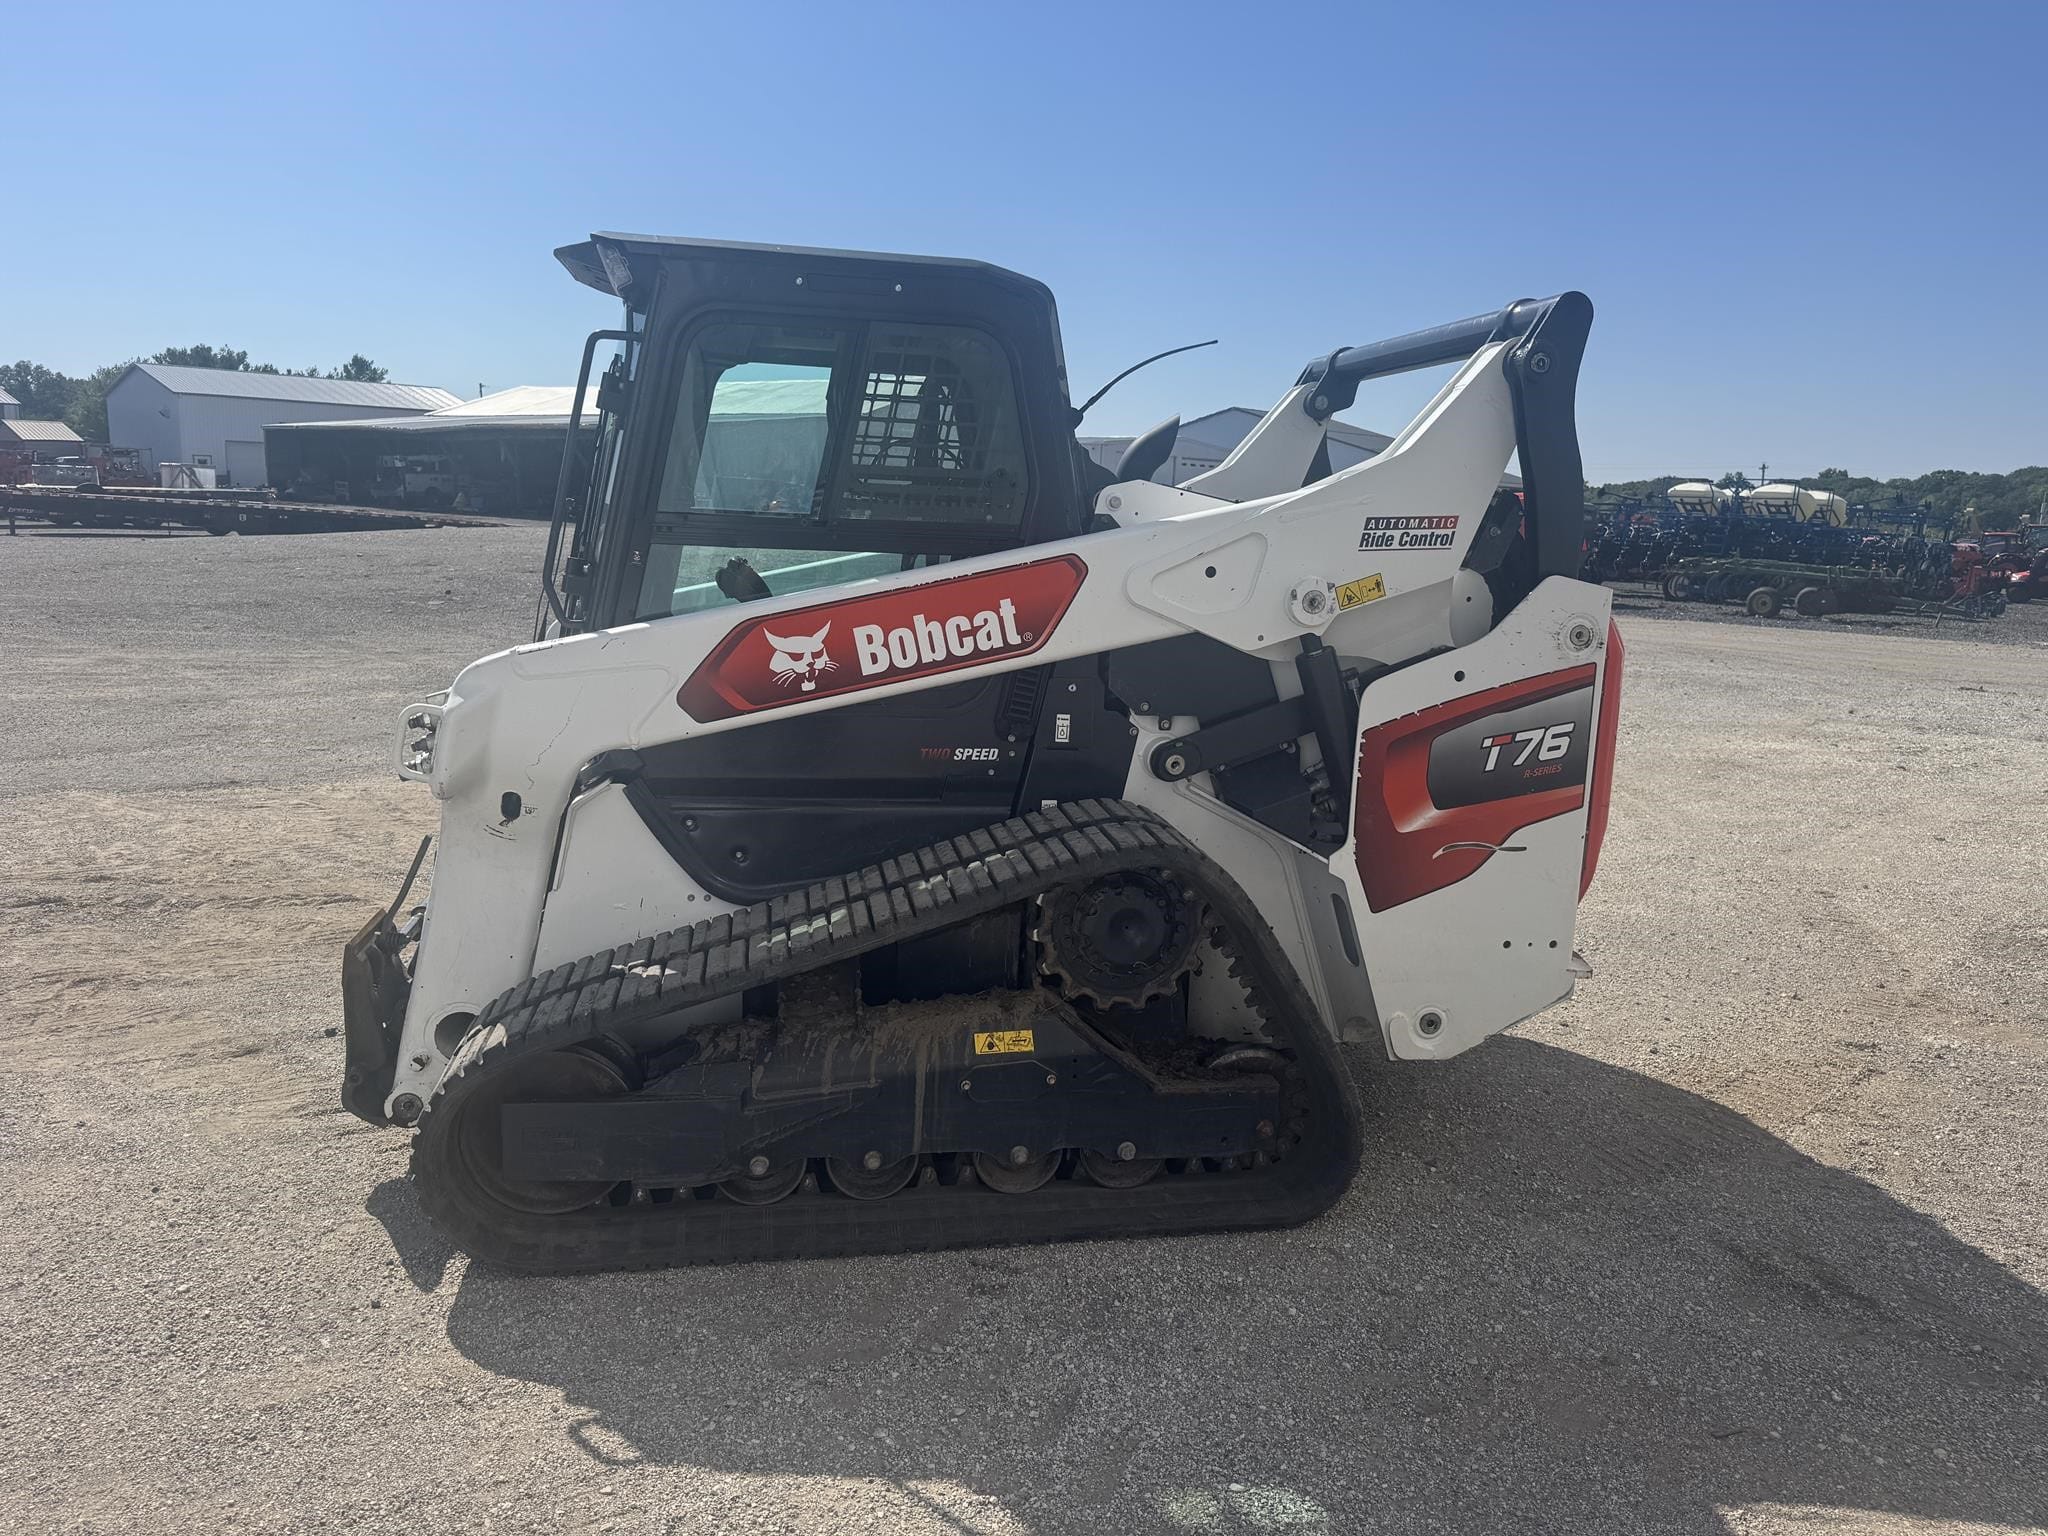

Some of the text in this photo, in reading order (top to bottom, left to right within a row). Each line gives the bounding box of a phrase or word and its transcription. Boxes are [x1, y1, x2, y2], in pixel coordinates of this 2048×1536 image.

[1367, 518, 1455, 529] AUTOMATIC
[1359, 531, 1456, 548] Ride Control
[853, 599, 1021, 675] Bobcat
[920, 748, 951, 760] TWO
[1482, 723, 1575, 771] T76
[1523, 764, 1562, 778] R-SERIES
